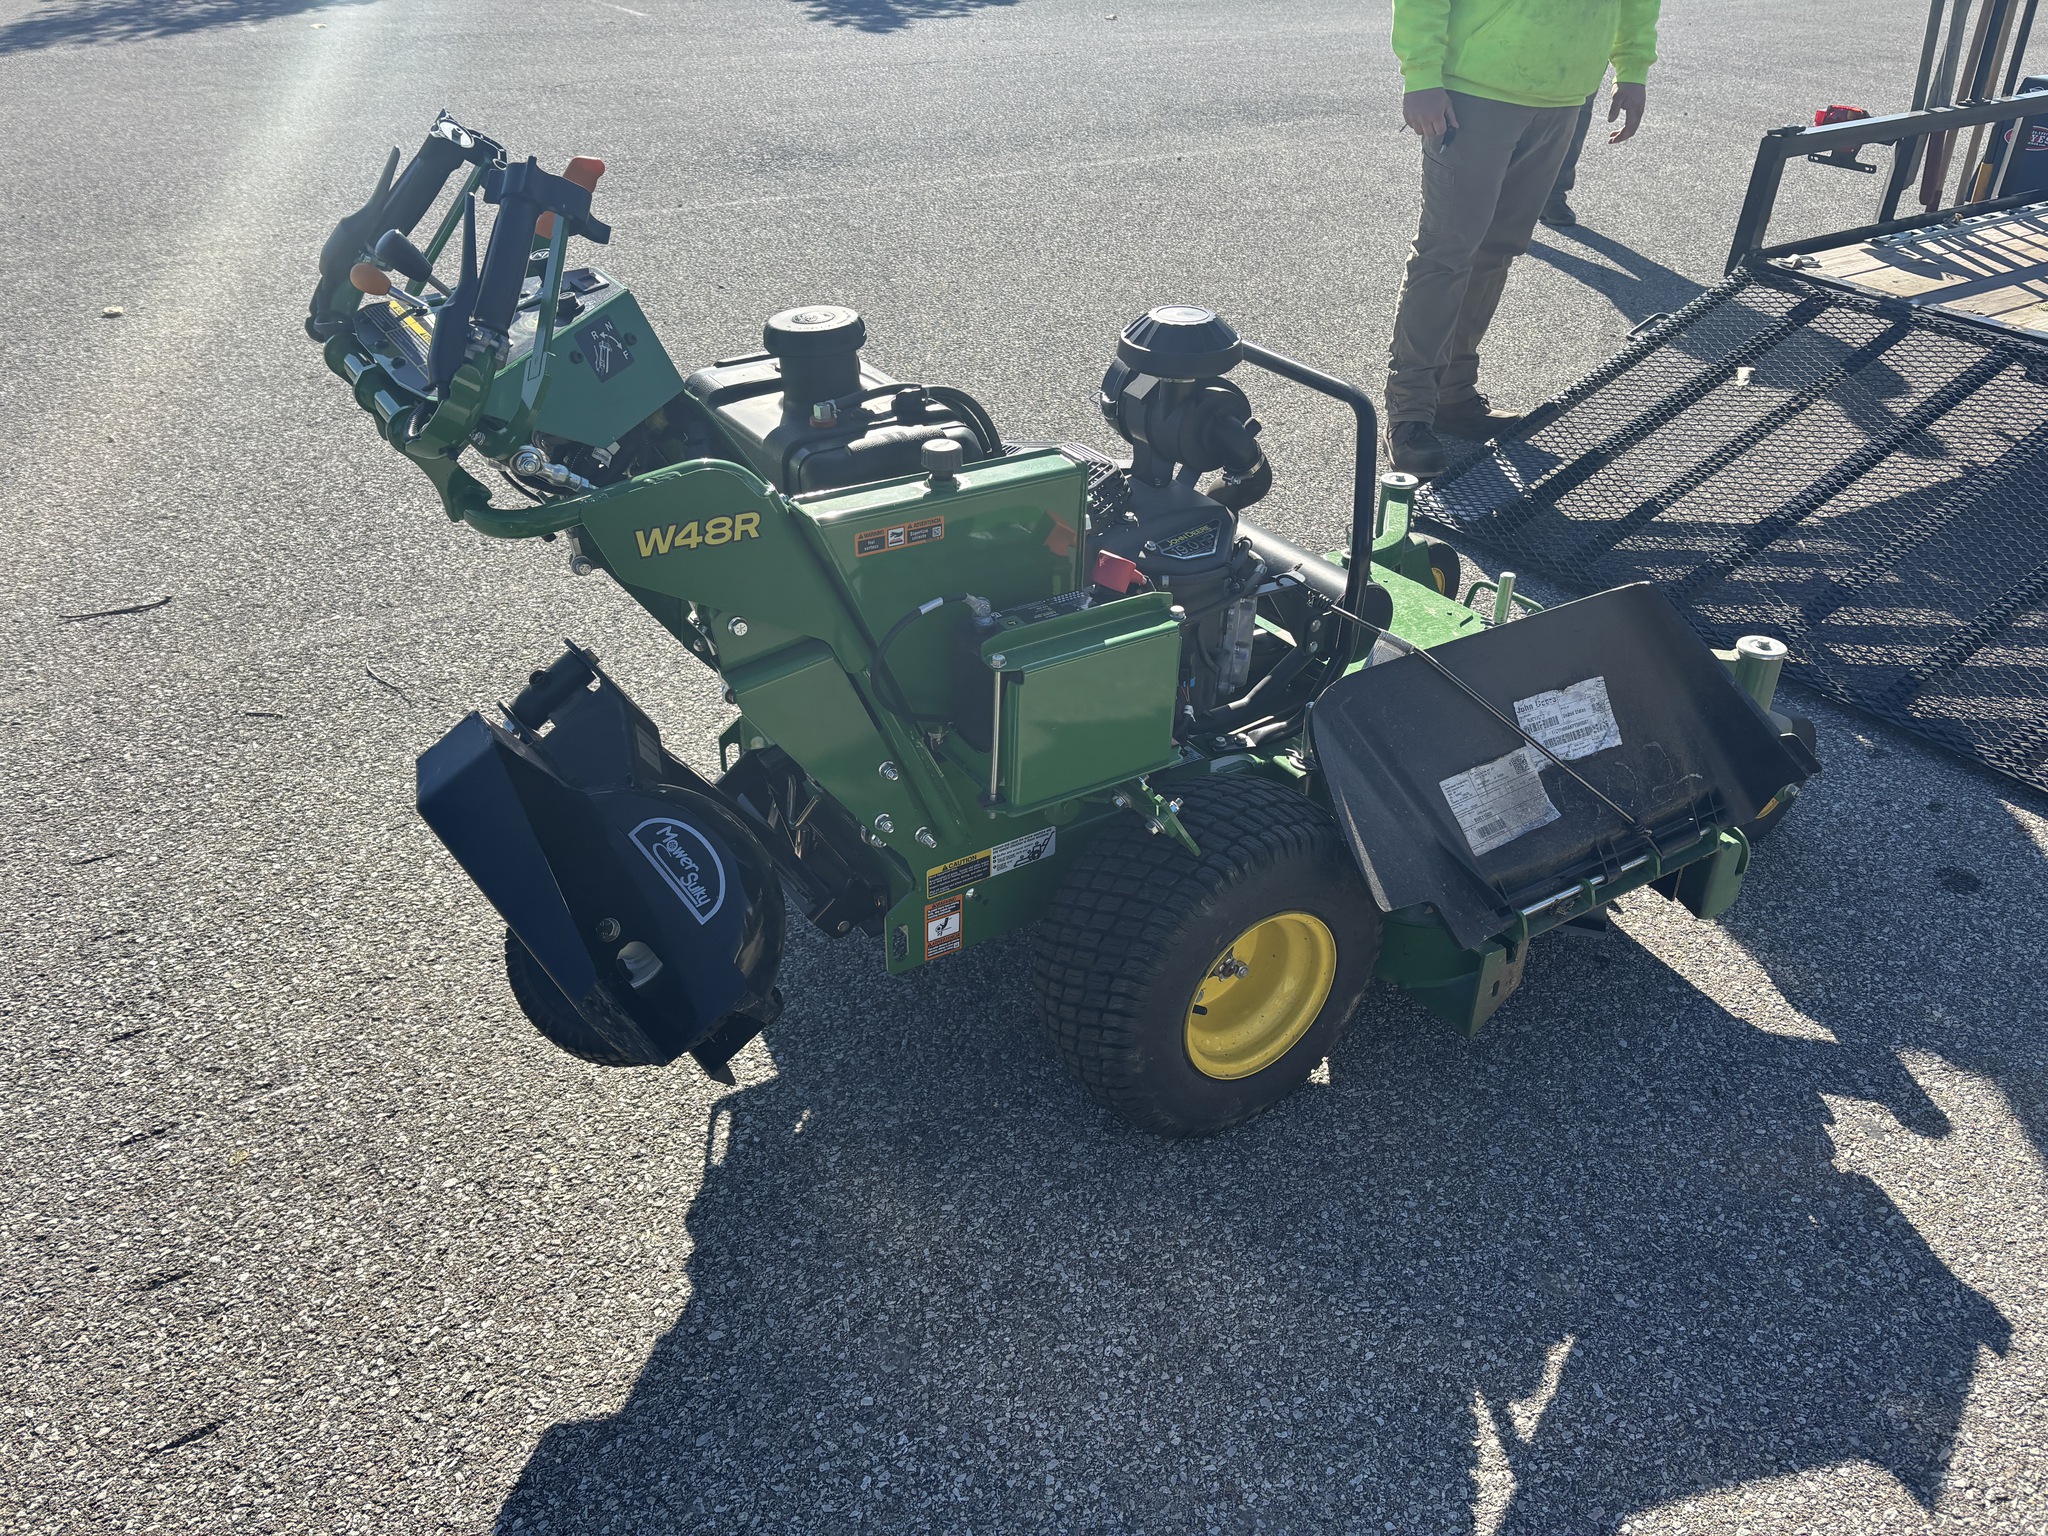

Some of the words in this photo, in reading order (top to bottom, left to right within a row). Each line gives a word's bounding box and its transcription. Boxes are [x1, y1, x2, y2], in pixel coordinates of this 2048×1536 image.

[605, 321, 613, 331] N
[591, 331, 599, 340] R
[622, 350, 630, 360] F
[634, 511, 761, 558] W48R
[1167, 533, 1187, 546] JOHN
[1187, 525, 1212, 538] DEERE
[1516, 703, 1534, 714] John
[656, 826, 699, 872] Mower
[680, 872, 711, 908] Sulky
[947, 854, 978, 870] CAUTION
